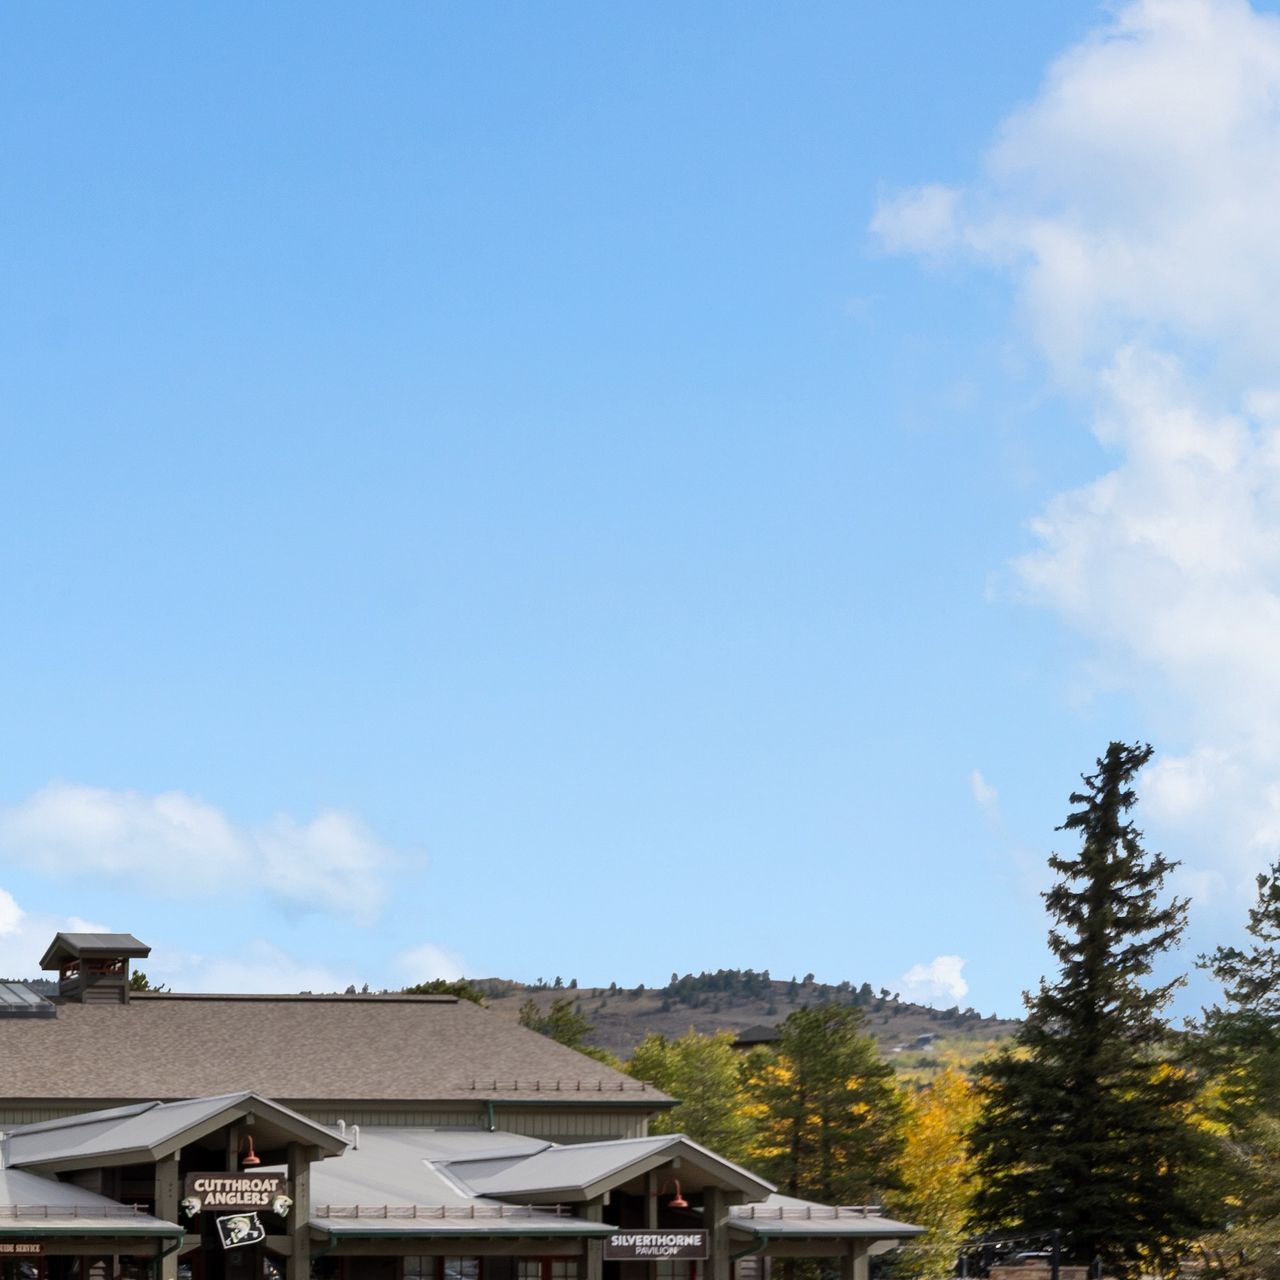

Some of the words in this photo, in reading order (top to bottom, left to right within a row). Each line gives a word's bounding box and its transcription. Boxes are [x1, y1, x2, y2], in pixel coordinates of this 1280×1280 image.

[193, 1178, 279, 1192] CUTTHROAT
[204, 1192, 269, 1205] ANGLERS
[611, 1234, 702, 1246] SILVERTHORNE
[635, 1246, 678, 1256] PAVILION
